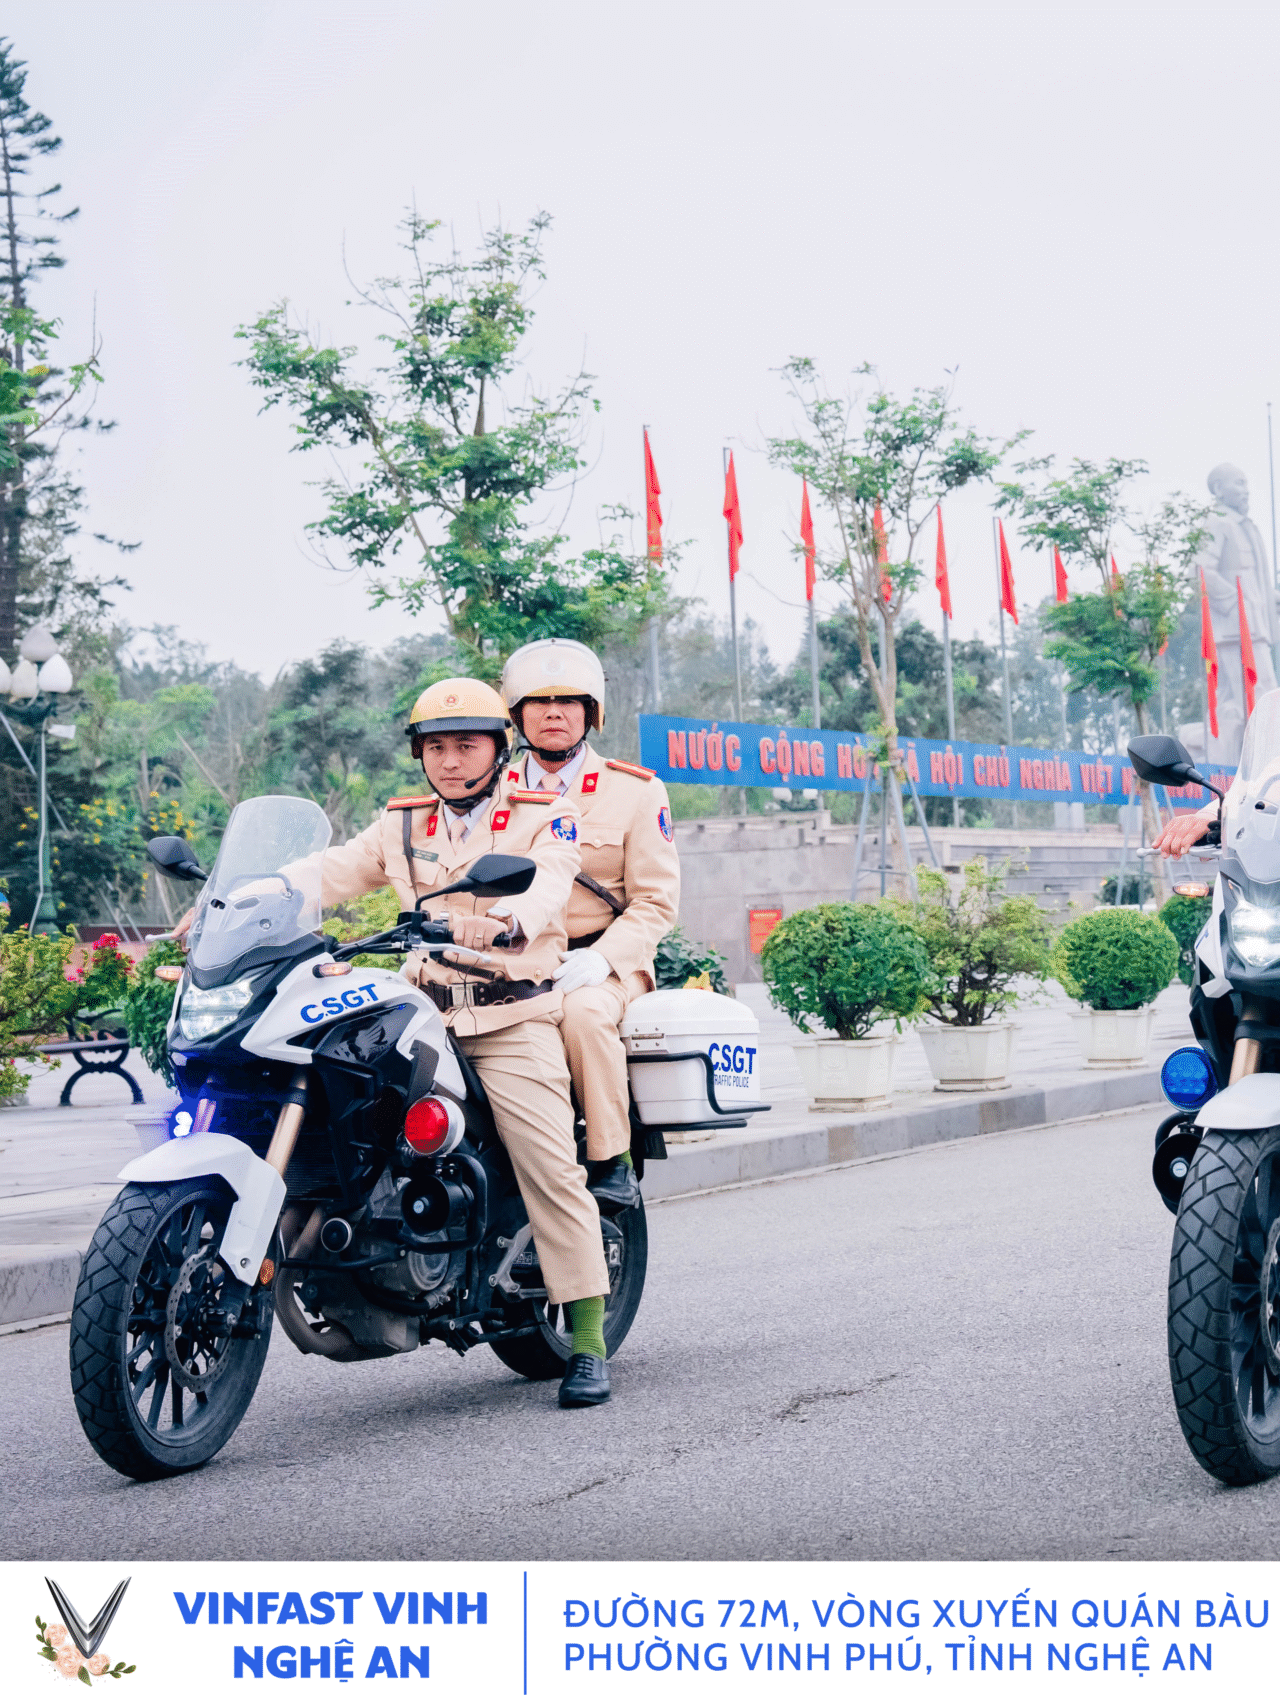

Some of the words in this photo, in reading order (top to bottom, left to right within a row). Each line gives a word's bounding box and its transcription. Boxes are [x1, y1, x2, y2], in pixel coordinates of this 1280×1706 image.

[668, 722, 741, 771] NƯỚC
[759, 730, 825, 782] CỘNG
[837, 736, 880, 779] HÒ
[930, 745, 963, 790] HỘI
[973, 745, 1010, 787] CHỦ
[1019, 755, 1072, 791] NGHĨA
[1080, 757, 1113, 799] VIỆT
[713, 1073, 732, 1086] RAFFIC
